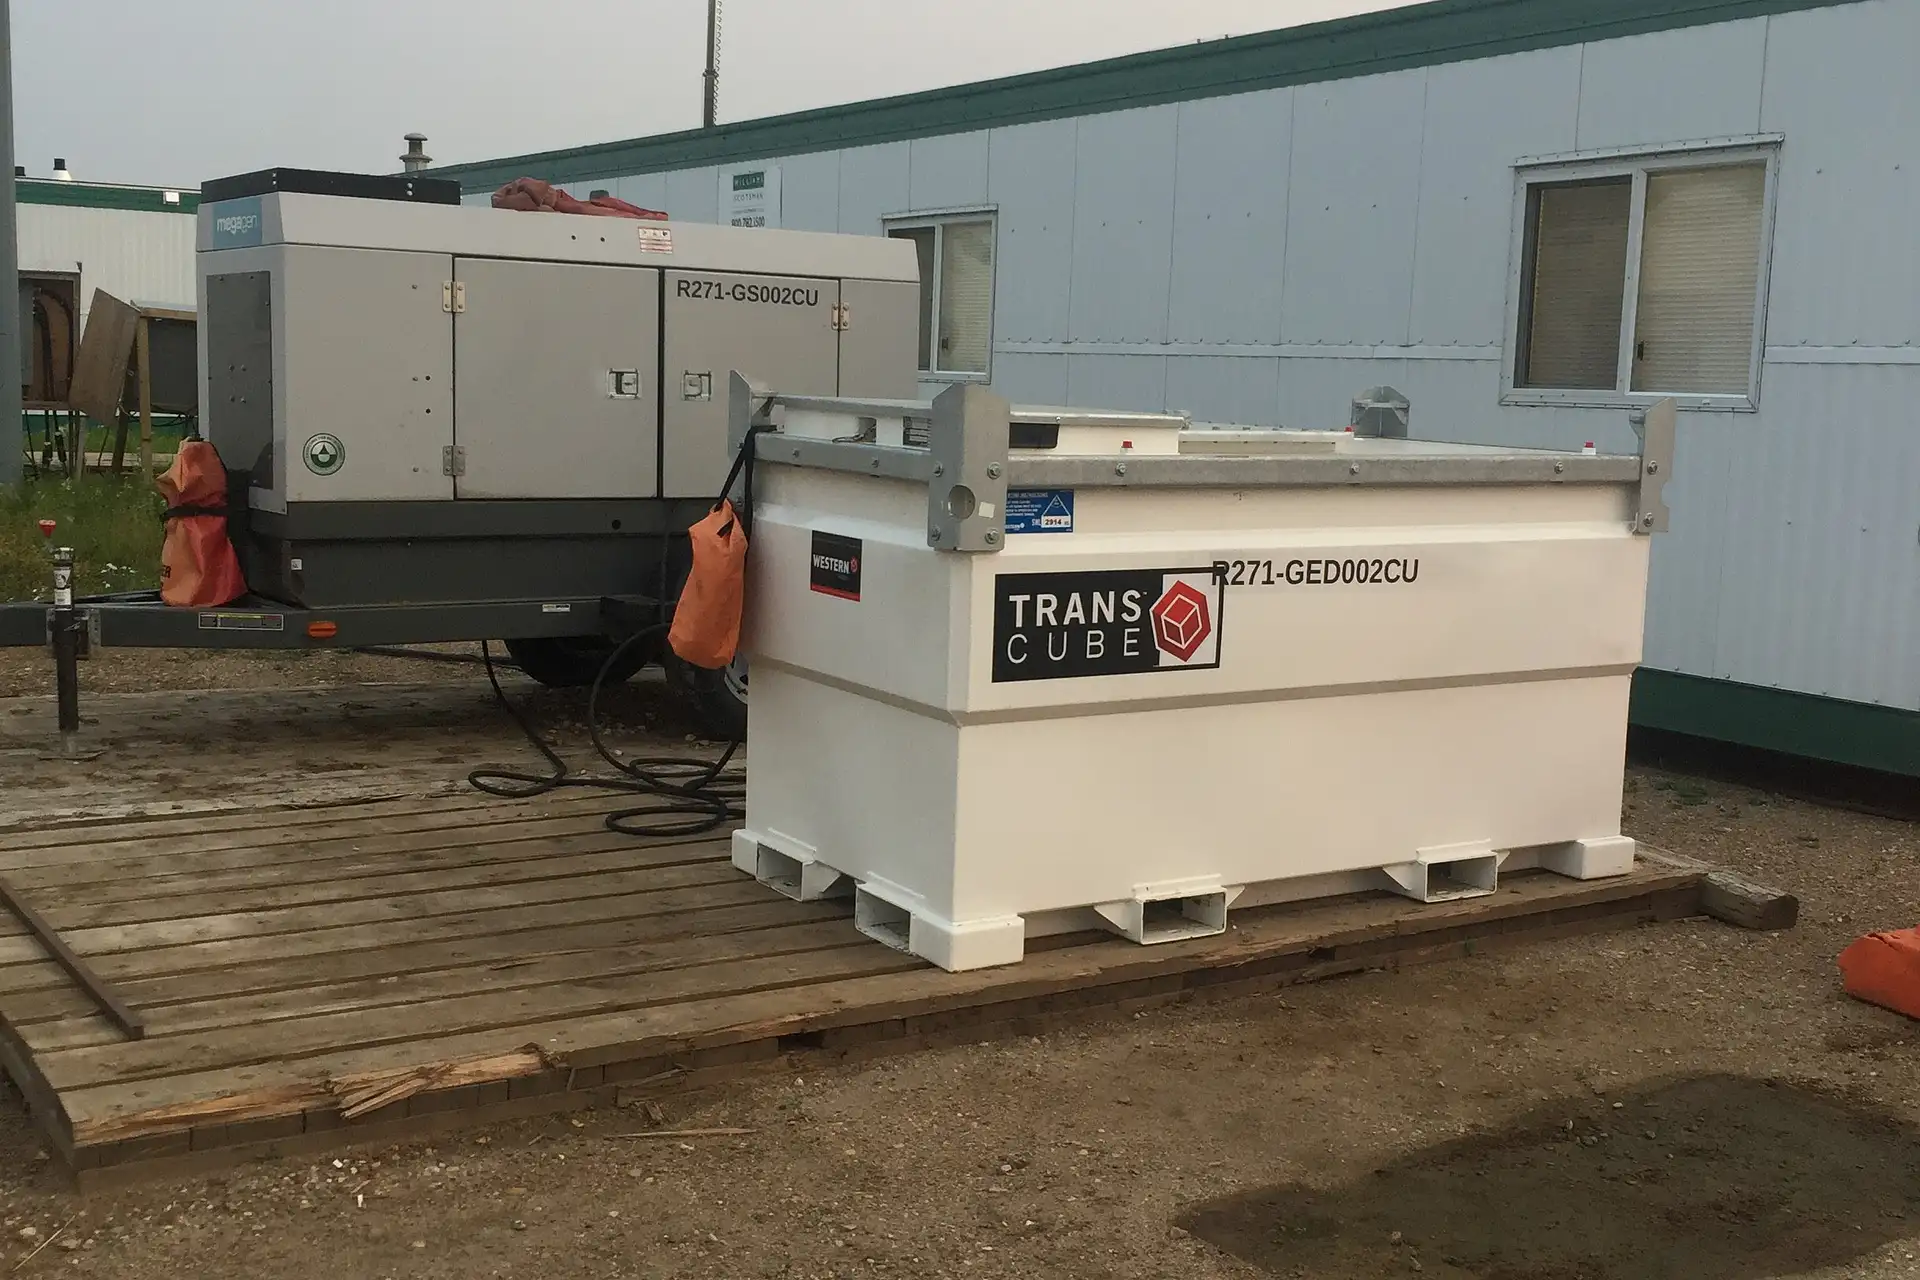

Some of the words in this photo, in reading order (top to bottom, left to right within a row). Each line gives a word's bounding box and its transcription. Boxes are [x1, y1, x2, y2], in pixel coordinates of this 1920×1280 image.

[677, 279, 819, 306] R271-GS002CU
[813, 554, 850, 574] WESTERN
[1211, 559, 1419, 585] R271-GED002CU
[1008, 589, 1142, 628] TRANS
[1007, 628, 1140, 664] CUBE
